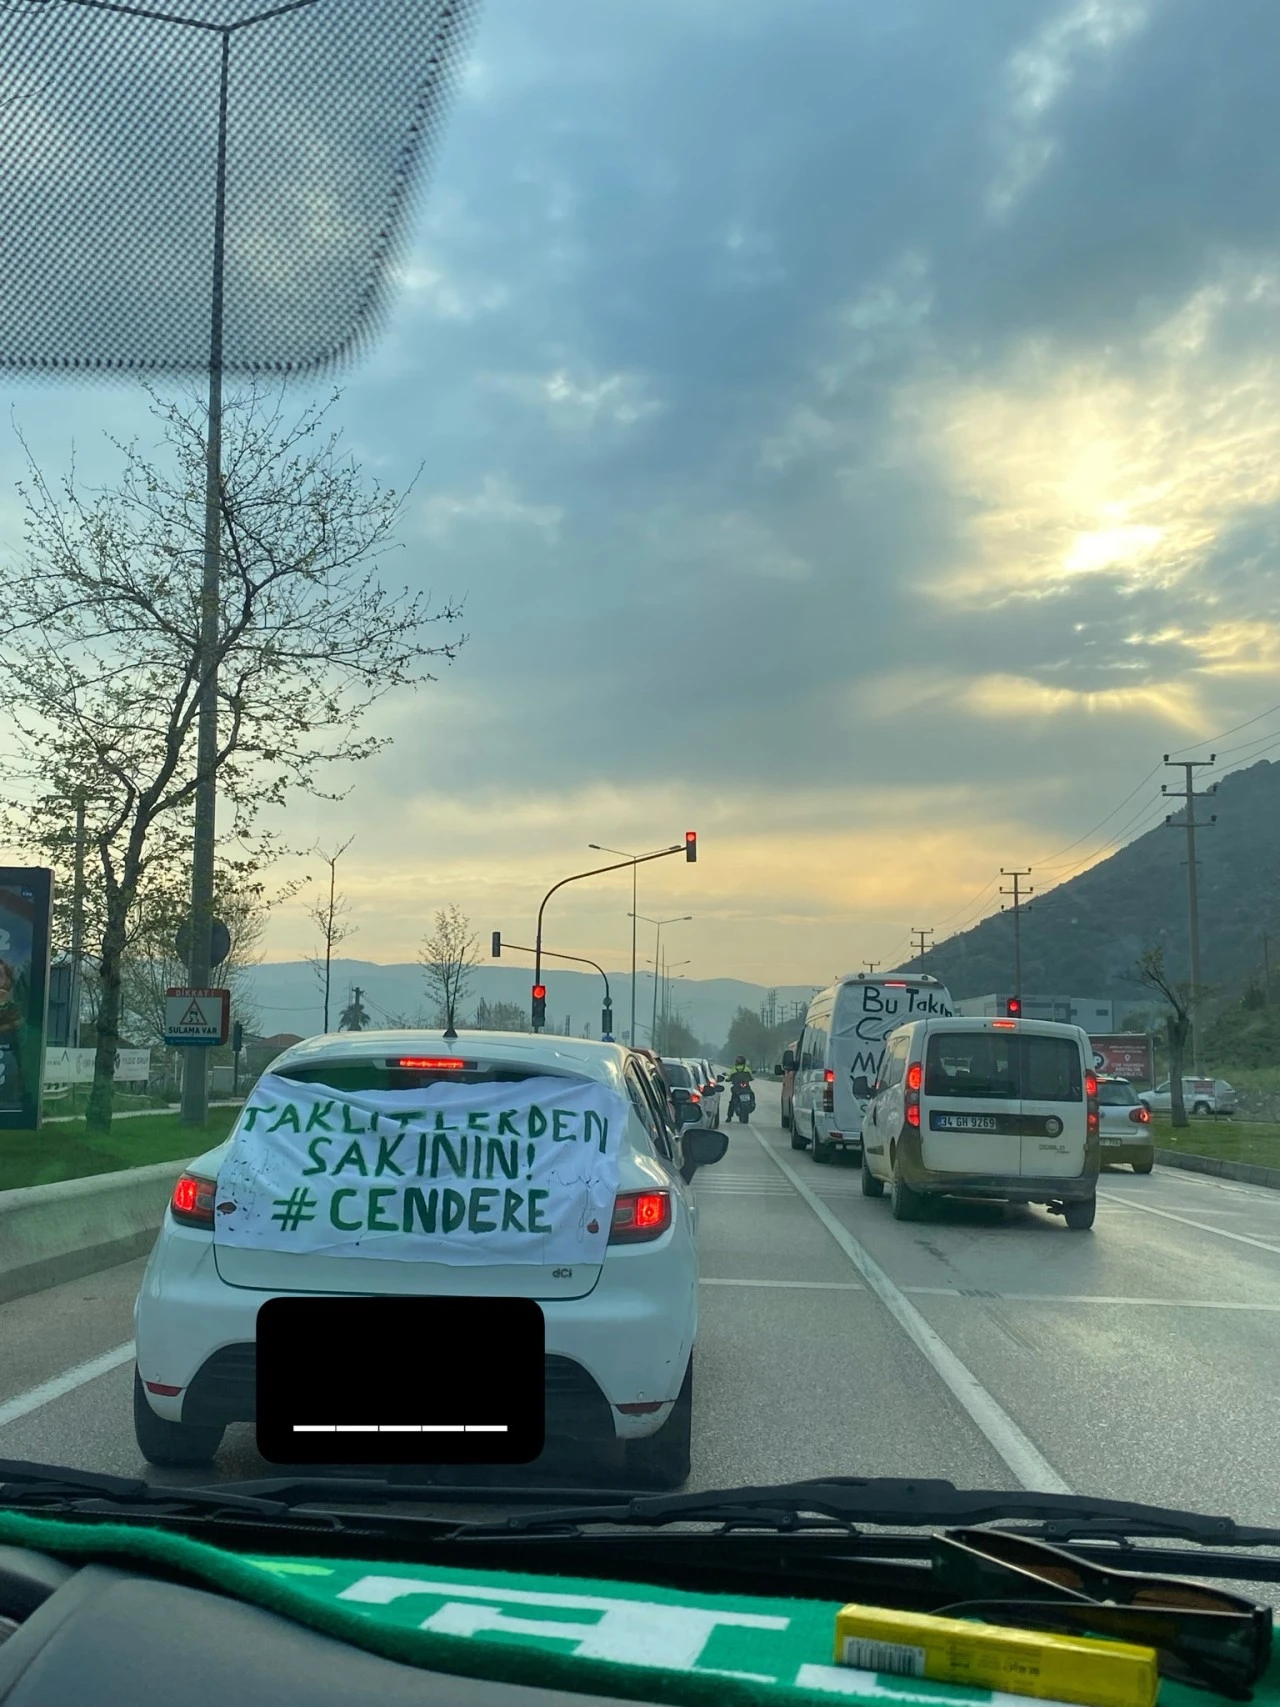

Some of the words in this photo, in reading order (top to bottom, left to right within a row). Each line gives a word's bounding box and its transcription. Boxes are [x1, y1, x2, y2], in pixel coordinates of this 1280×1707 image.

[862, 986, 898, 1014] Bu
[168, 1026, 200, 1034] SULAMA
[201, 1026, 218, 1034] VAR
[941, 1116, 953, 1127] 34
[956, 1116, 968, 1127] GH
[971, 1117, 995, 1128] 9269
[271, 1187, 552, 1234] #CENDERE
